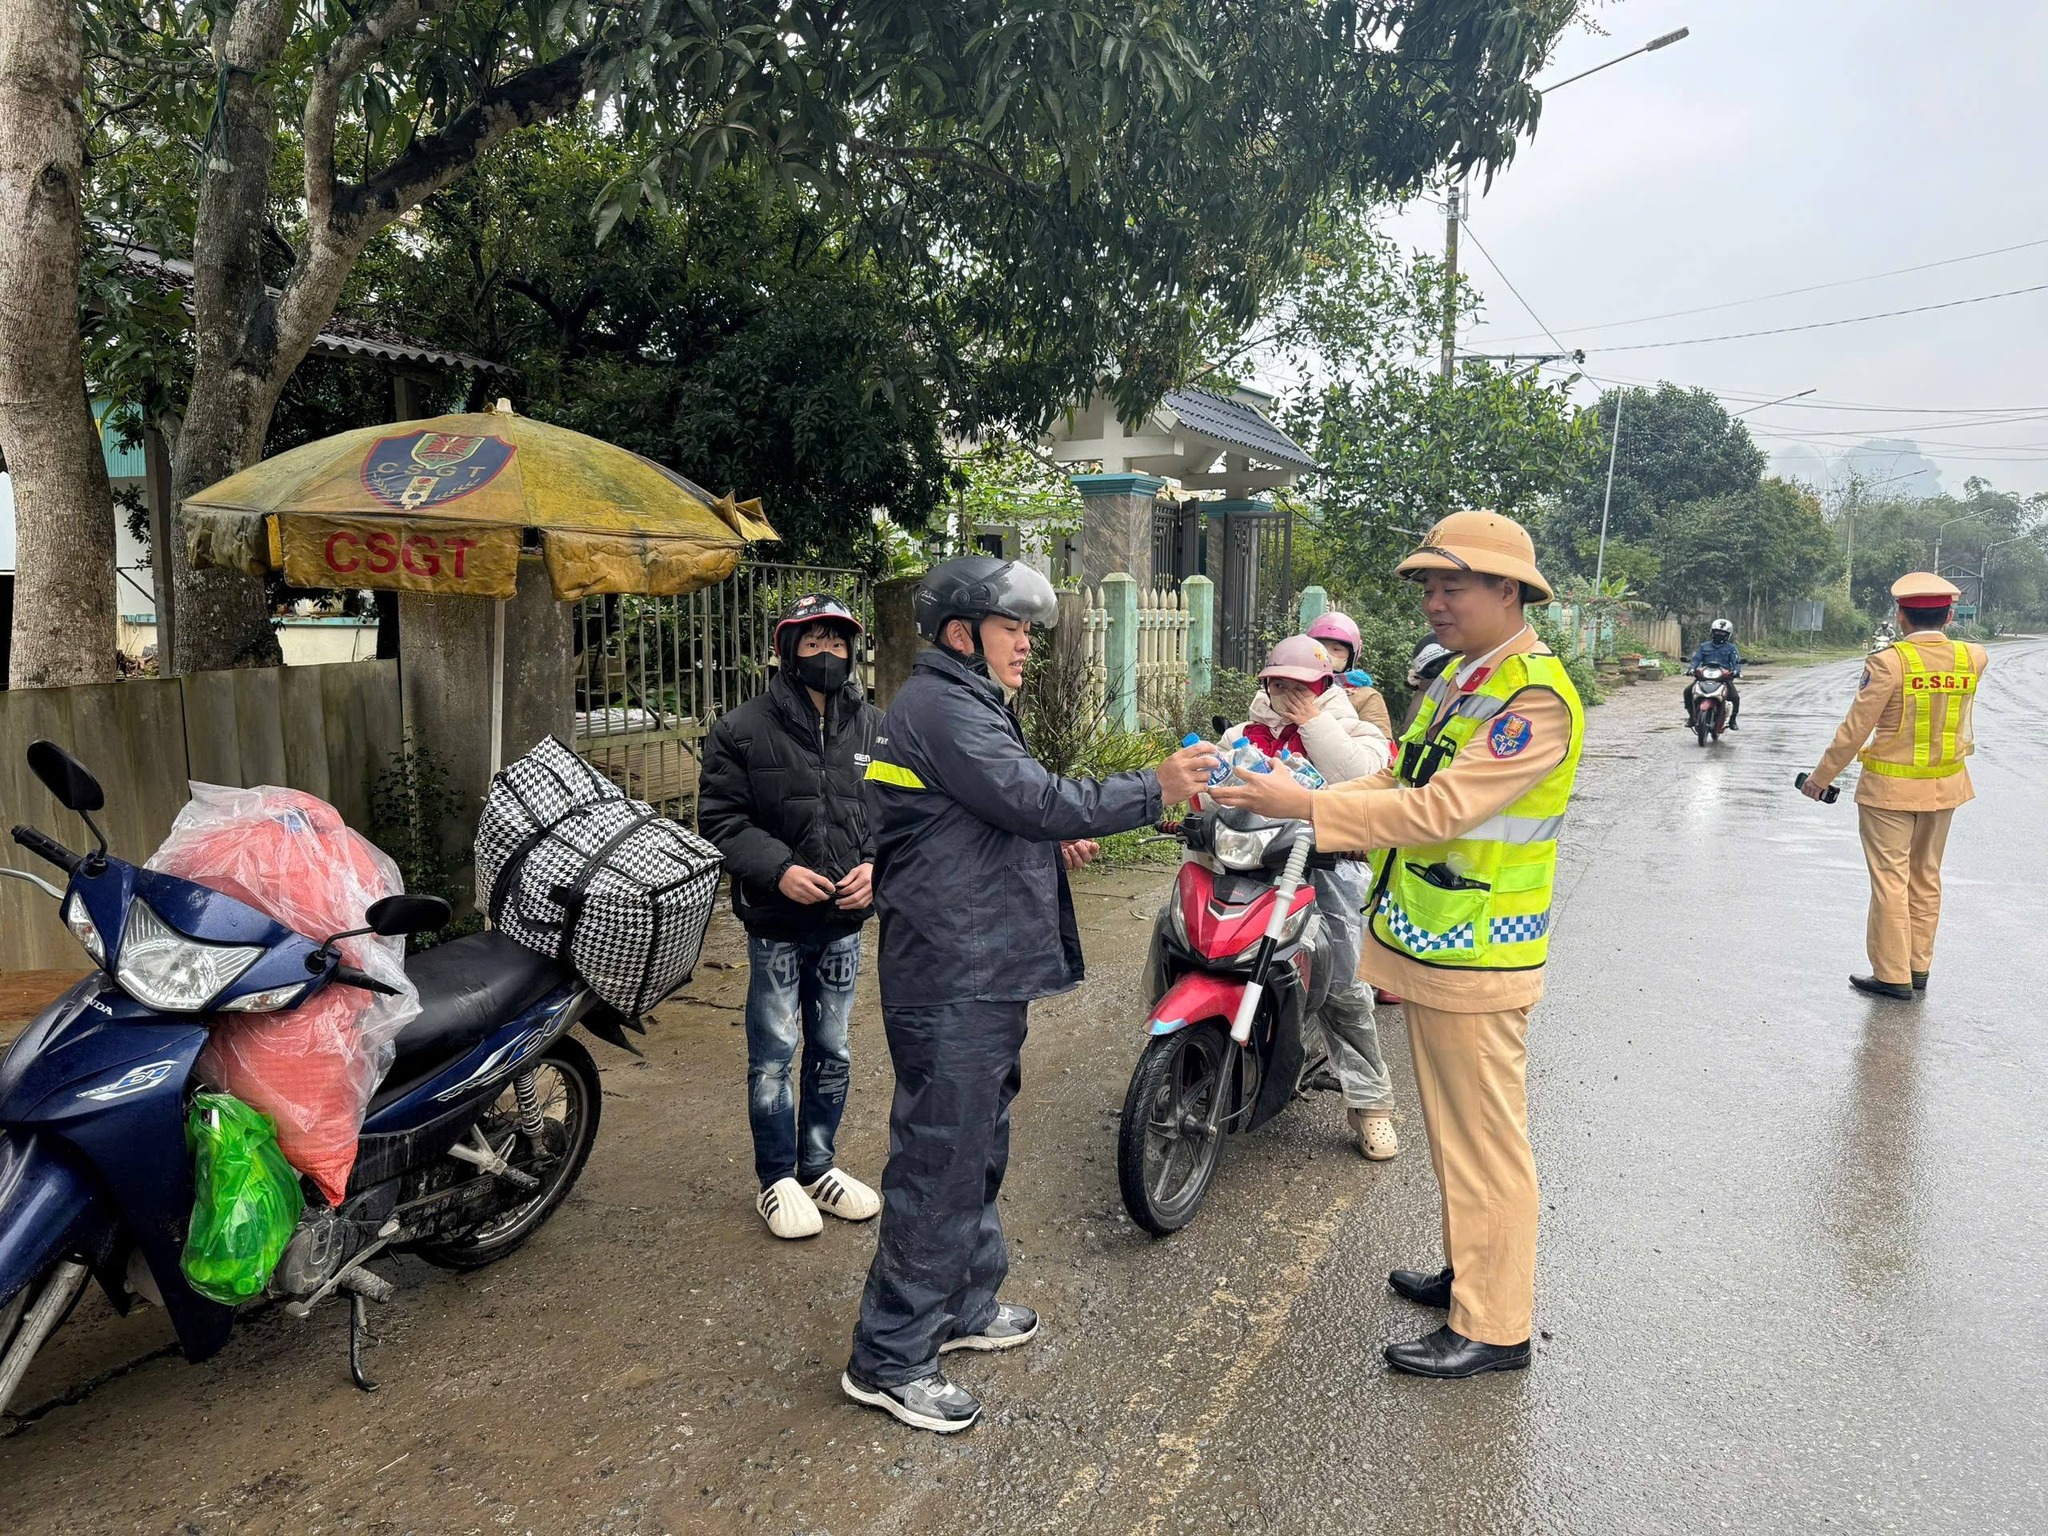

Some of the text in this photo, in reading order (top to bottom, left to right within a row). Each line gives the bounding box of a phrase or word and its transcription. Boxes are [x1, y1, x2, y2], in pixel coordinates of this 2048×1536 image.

[377, 462, 487, 478] CSGT
[325, 531, 478, 578] CSGT
[1911, 675, 1970, 689] C.S.G.T
